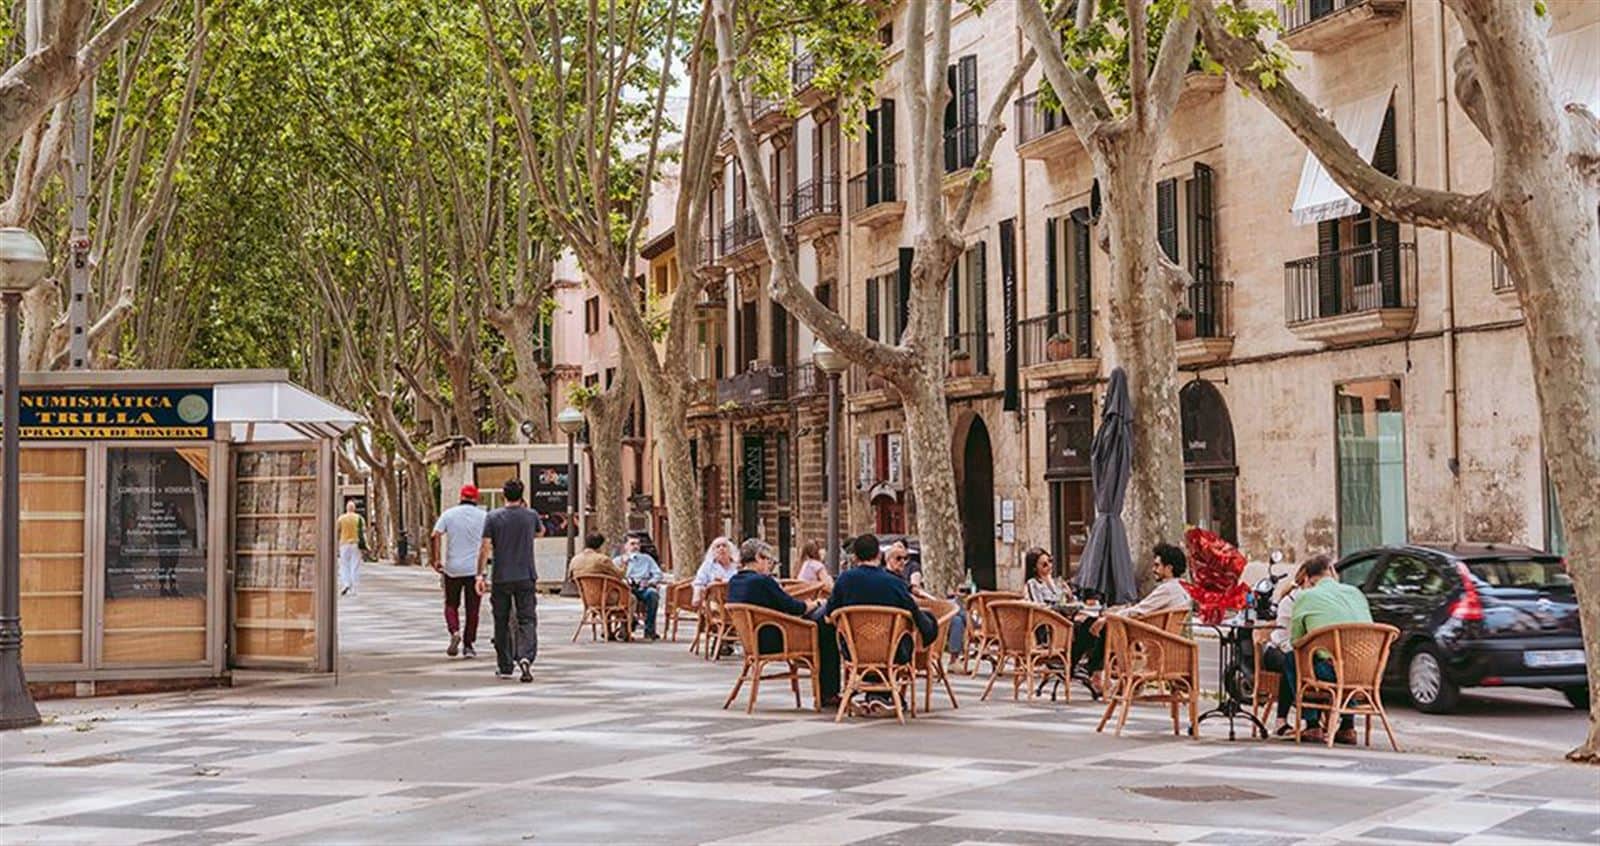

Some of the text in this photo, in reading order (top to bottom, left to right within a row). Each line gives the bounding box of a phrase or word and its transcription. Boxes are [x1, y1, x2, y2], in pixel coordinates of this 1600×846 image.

[20, 392, 173, 408] NUMISMÁTICA
[35, 411, 157, 424] TRILLA
[110, 427, 128, 438] DE
[134, 427, 204, 438] MONEDAS
